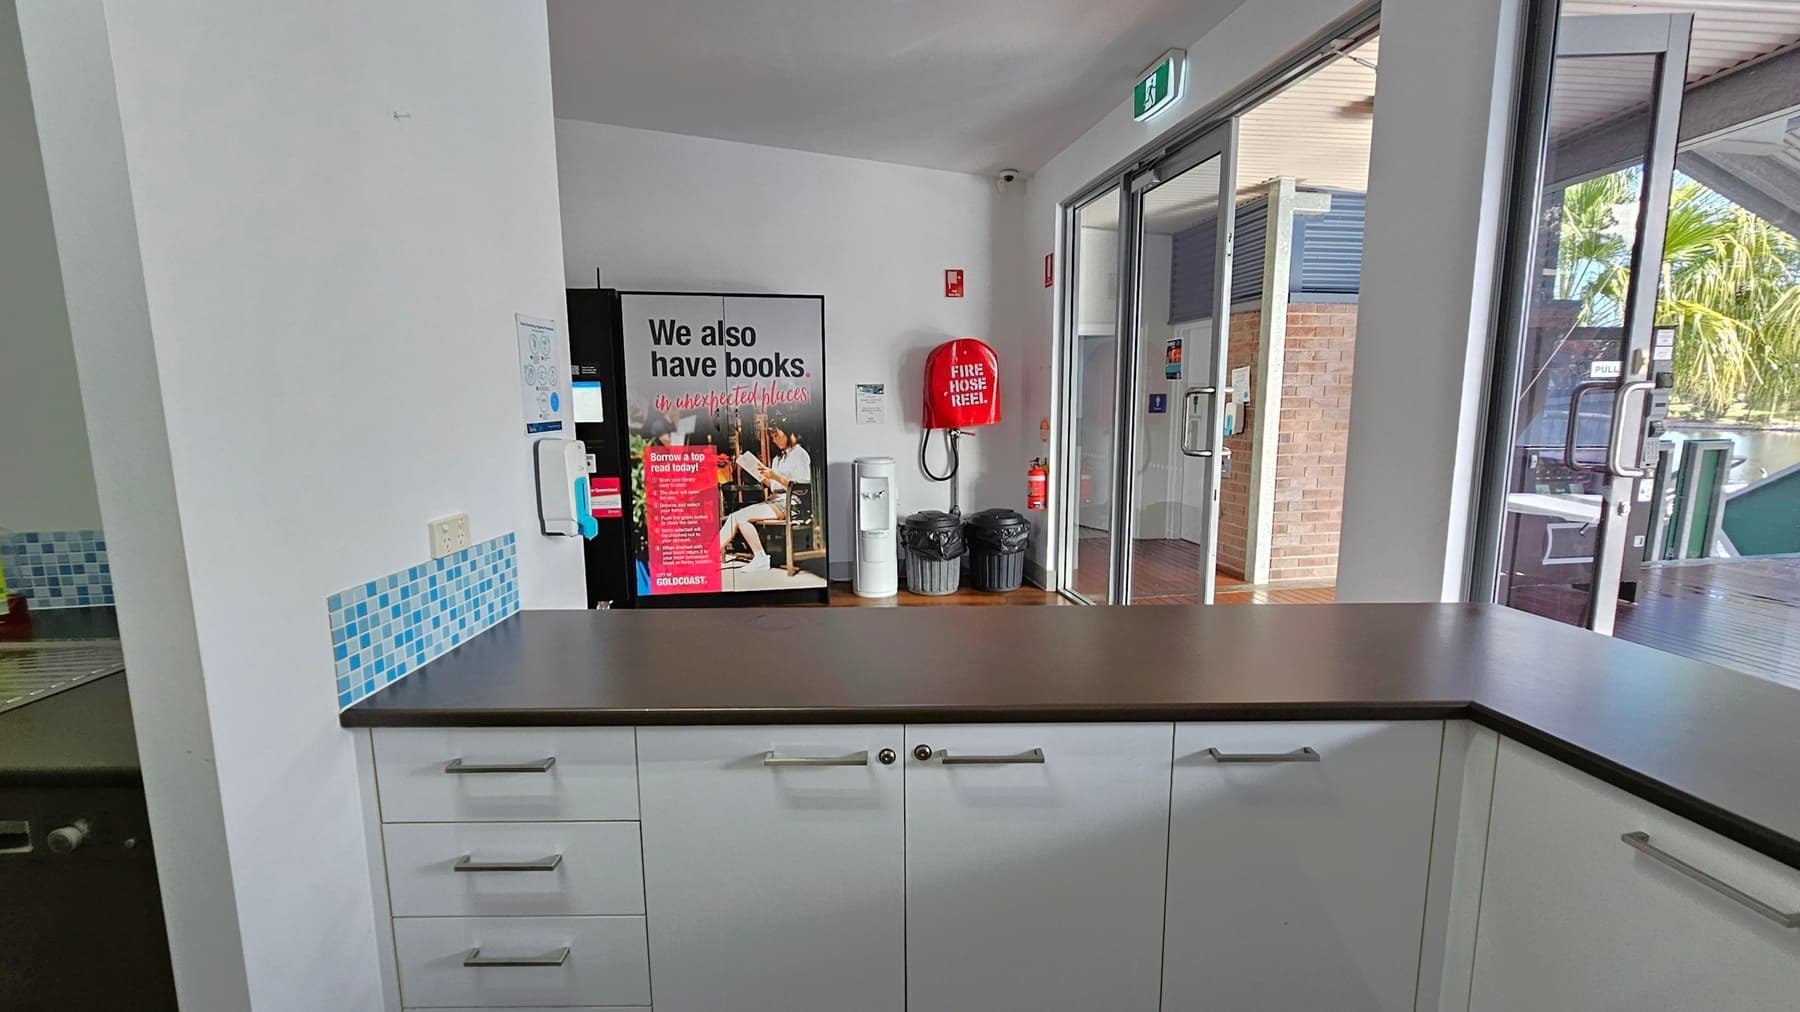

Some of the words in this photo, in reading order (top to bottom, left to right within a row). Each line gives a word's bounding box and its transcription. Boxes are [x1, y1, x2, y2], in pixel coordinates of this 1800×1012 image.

[648, 318, 691, 346] We
[701, 320, 756, 347] also
[651, 351, 717, 377] have
[726, 352, 811, 378] books.
[951, 363, 984, 378] FIRE
[1595, 365, 1620, 373] PULL
[949, 377, 987, 393] HOSE
[655, 394, 672, 411] in
[676, 382, 759, 416] unexpected
[951, 391, 988, 407] REEL
[650, 452, 681, 462] Borrow
[683, 453, 689, 461] a
[691, 452, 705, 463] top
[651, 463, 670, 472] read
[672, 462, 699, 473] today!
